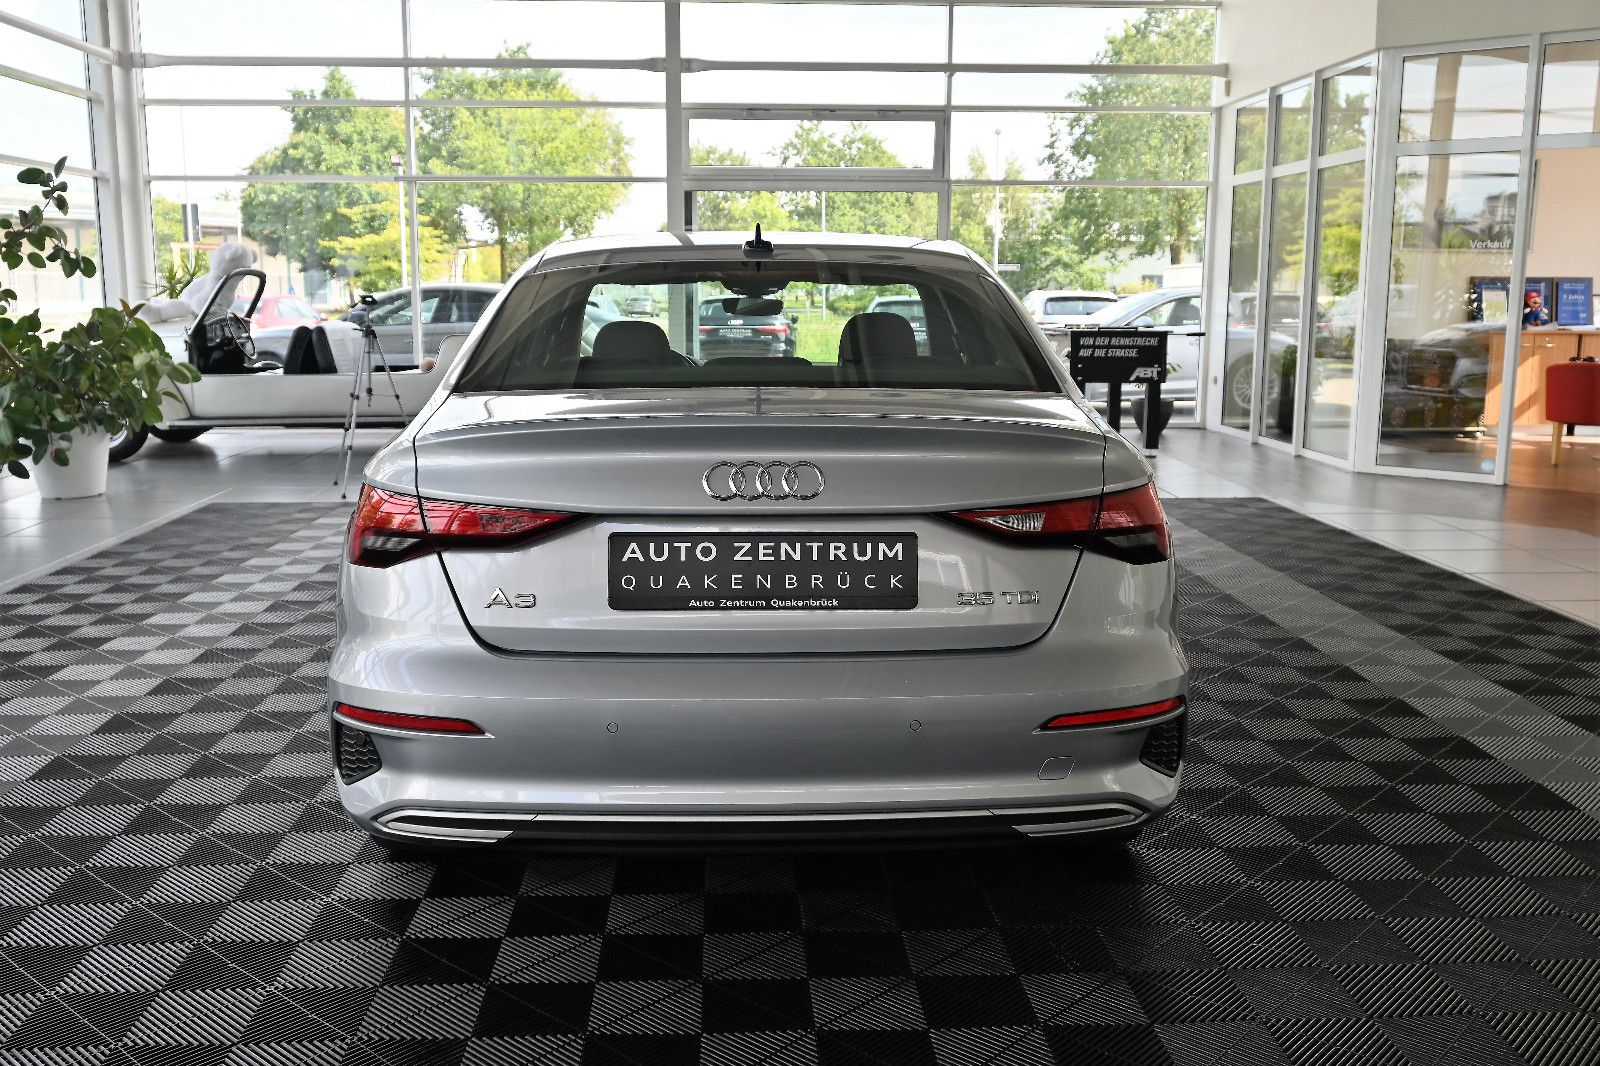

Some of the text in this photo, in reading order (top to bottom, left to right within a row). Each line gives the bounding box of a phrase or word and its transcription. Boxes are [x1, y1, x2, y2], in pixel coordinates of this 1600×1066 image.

[1469, 239, 1511, 249] Verkauf
[1080, 336, 1160, 347] VON DER RENNSTRECKE
[1079, 348, 1139, 357] AUF DIE STRASSE.
[1129, 367, 1162, 381] ABT
[621, 542, 903, 562] AUTO ZENTRUM
[621, 572, 904, 591] QUAKENBRÜCK
[484, 586, 537, 609] A3
[688, 597, 839, 608] Auto Zentrum Quakenbrück
[956, 590, 1039, 606] 35 TDI
